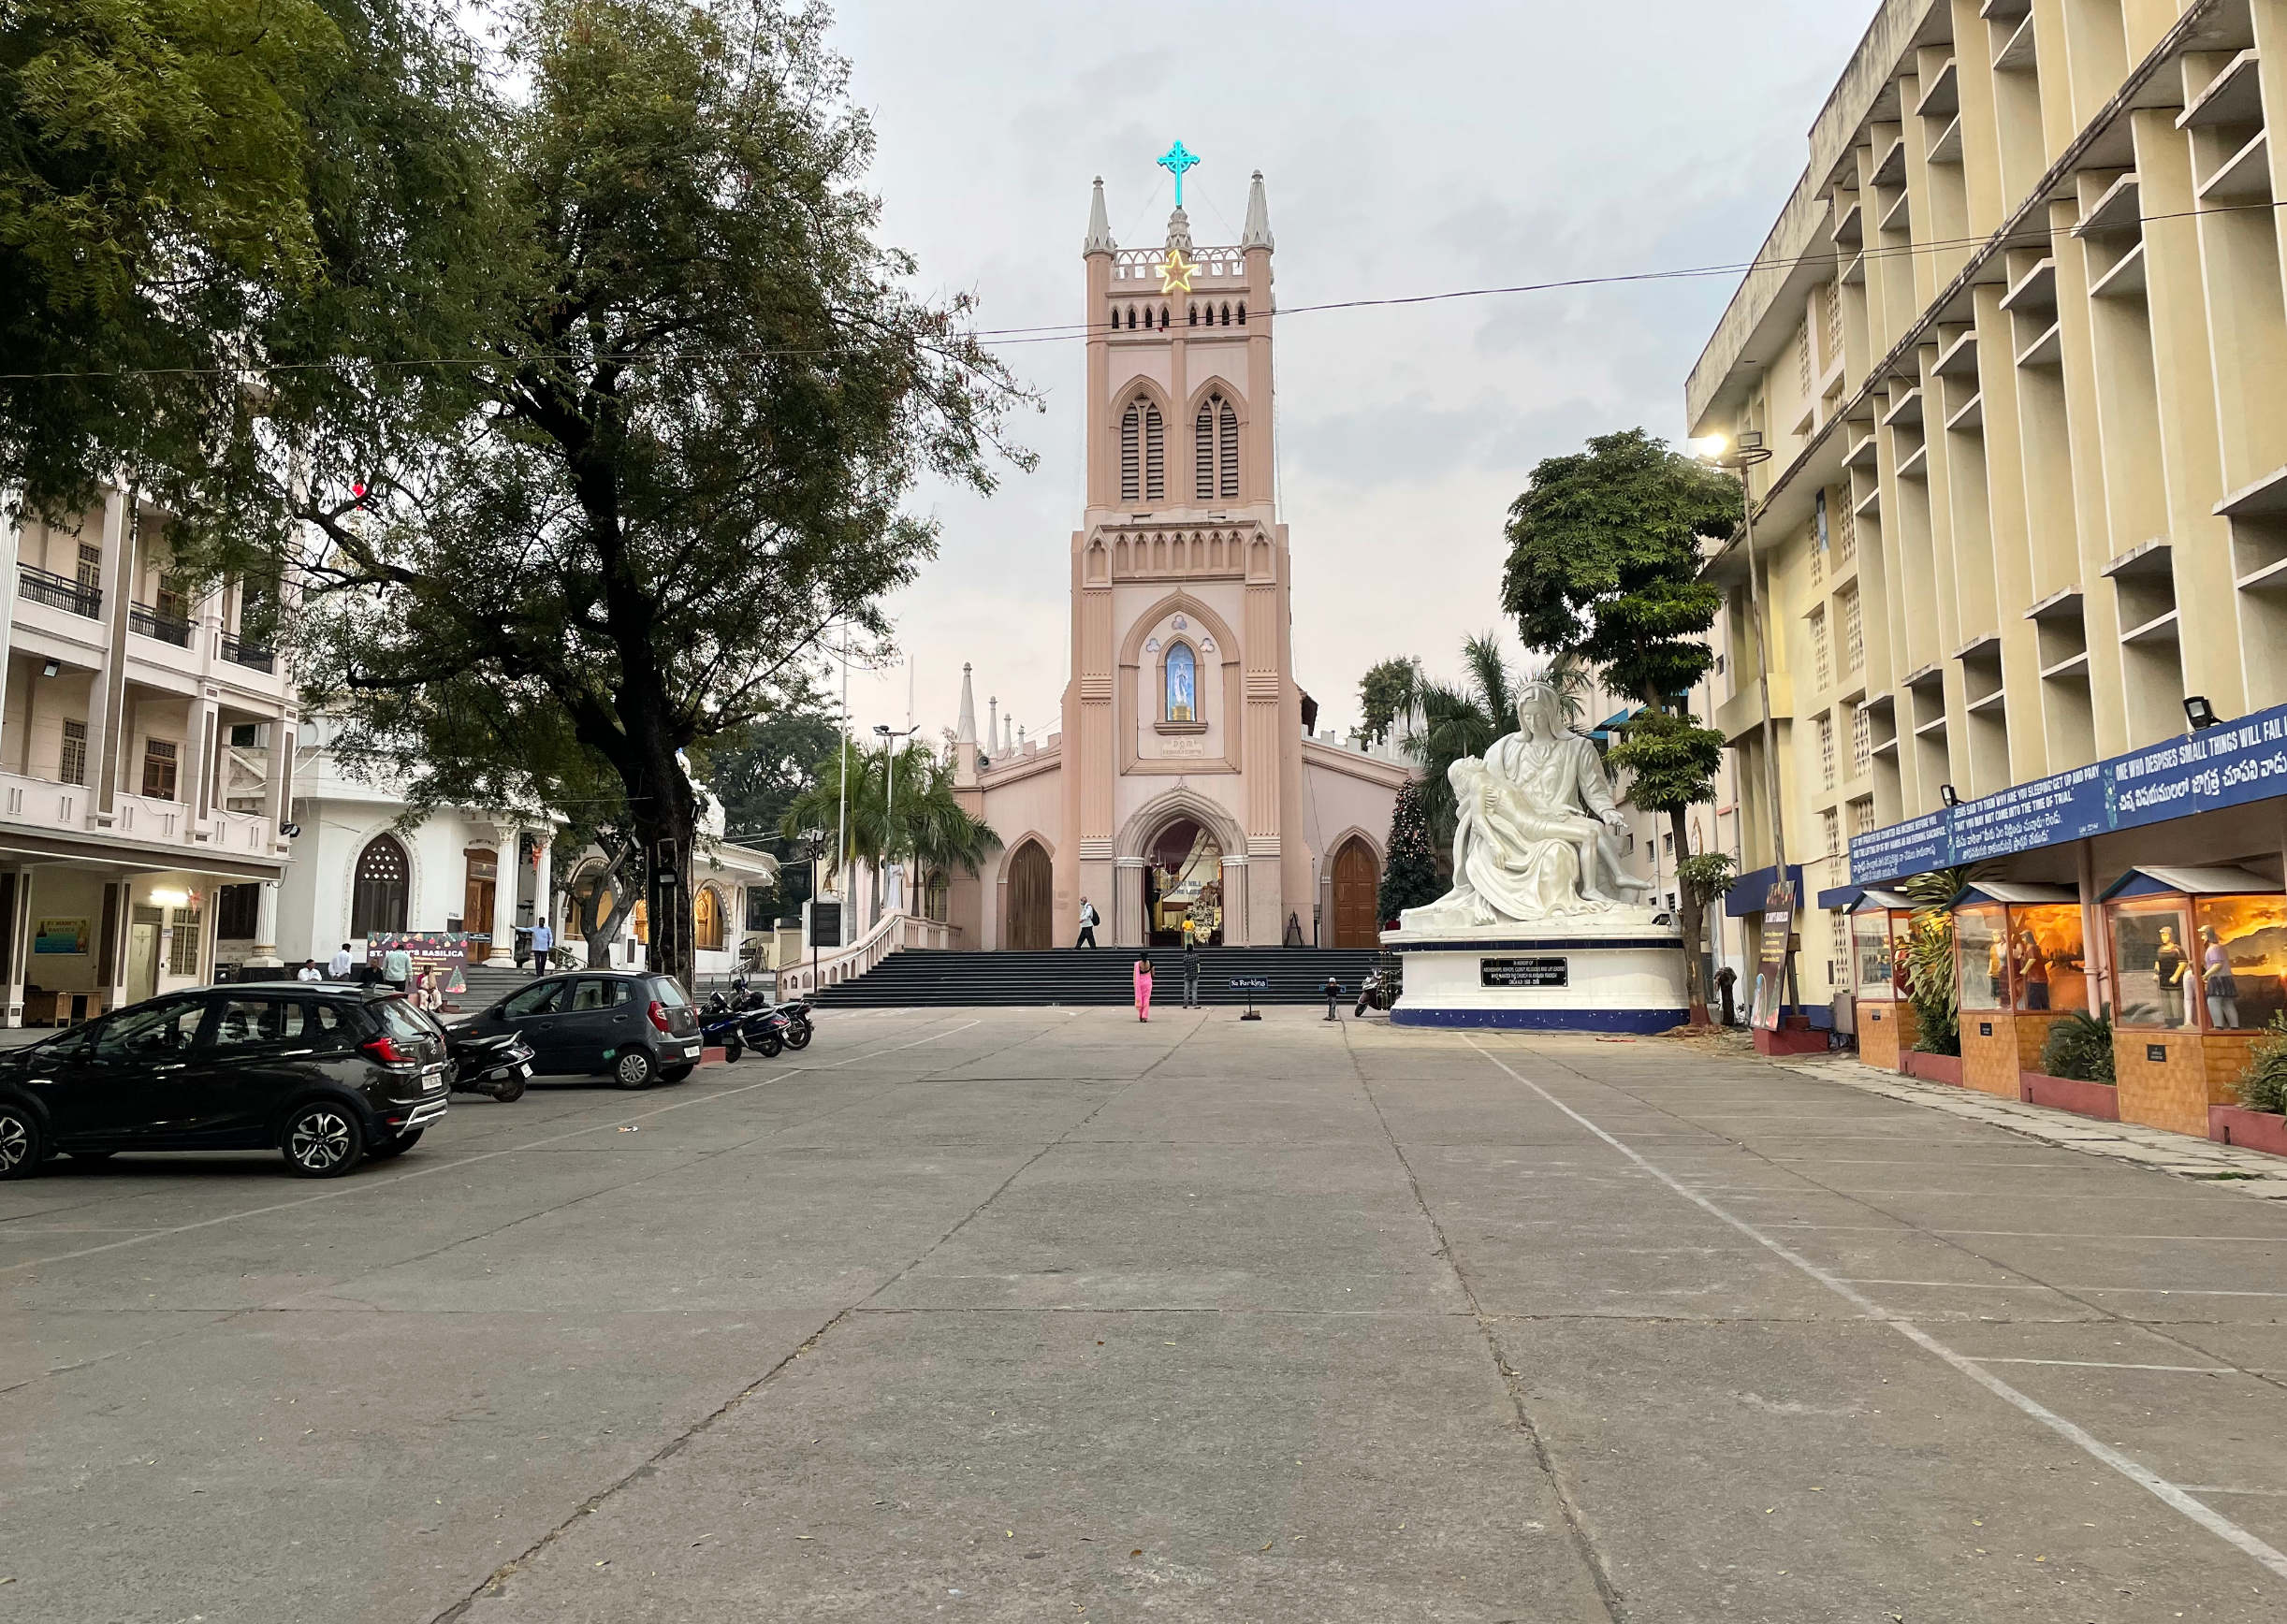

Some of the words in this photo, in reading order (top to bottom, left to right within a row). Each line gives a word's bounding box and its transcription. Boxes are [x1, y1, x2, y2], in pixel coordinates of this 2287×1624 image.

[2116, 762, 2128, 781] ONE
[2128, 757, 2144, 778] WHO
[2145, 748, 2178, 774] DESPISES
[2178, 741, 2207, 764] SMALL
[2208, 731, 2238, 756] THINGS
[2239, 724, 2261, 748] WILL
[2263, 718, 2283, 741] FAIL
[1976, 801, 1983, 812] TO
[2007, 790, 2017, 804] ARE
[2018, 788, 2027, 800] YOU
[2064, 774, 2072, 787] UP
[2072, 770, 2083, 784] AND
[2084, 764, 2099, 781] PRAY
[2021, 802, 2032, 814] THE
[2032, 798, 2045, 811] TIME
[2046, 795, 2053, 808] OF
[1239, 977, 1266, 986] Parking
